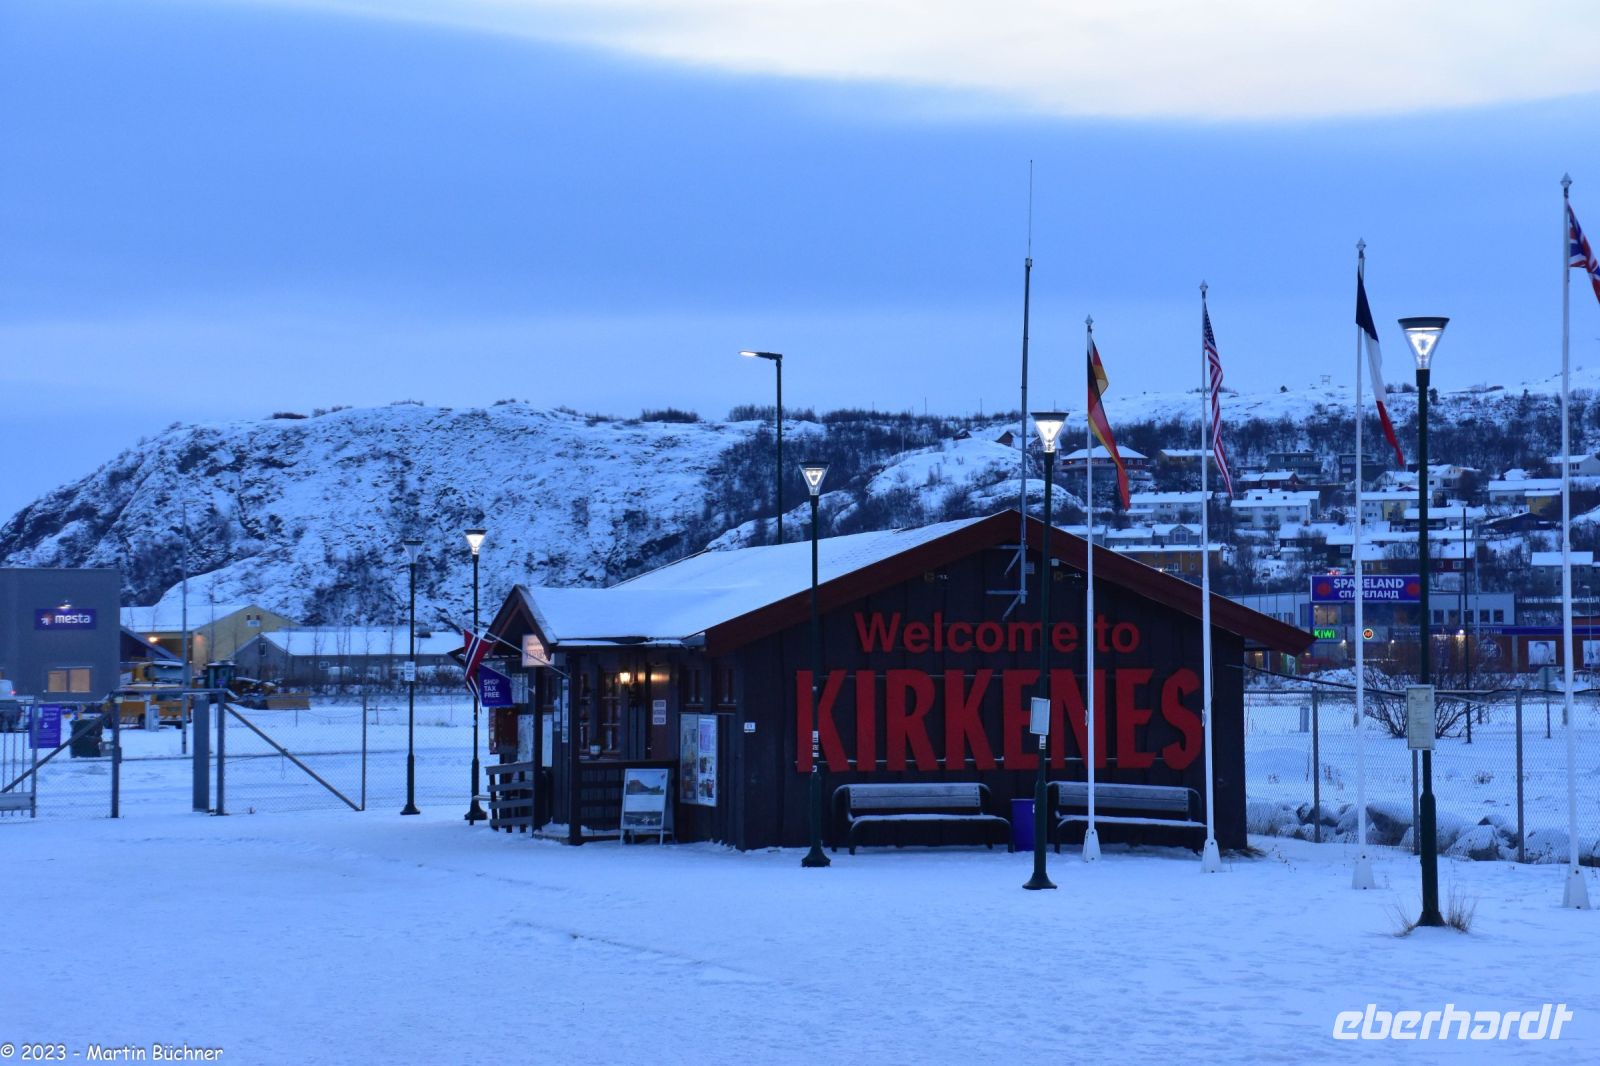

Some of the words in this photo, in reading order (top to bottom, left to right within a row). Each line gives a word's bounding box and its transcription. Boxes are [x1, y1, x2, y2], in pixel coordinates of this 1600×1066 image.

[1333, 578, 1405, 589] SPAELAND
[55, 613, 91, 624] mesta
[853, 611, 1080, 654] Welcome
[1095, 613, 1140, 654] to
[1314, 629, 1336, 639] KIWI
[794, 667, 1204, 773] KIRKENES
